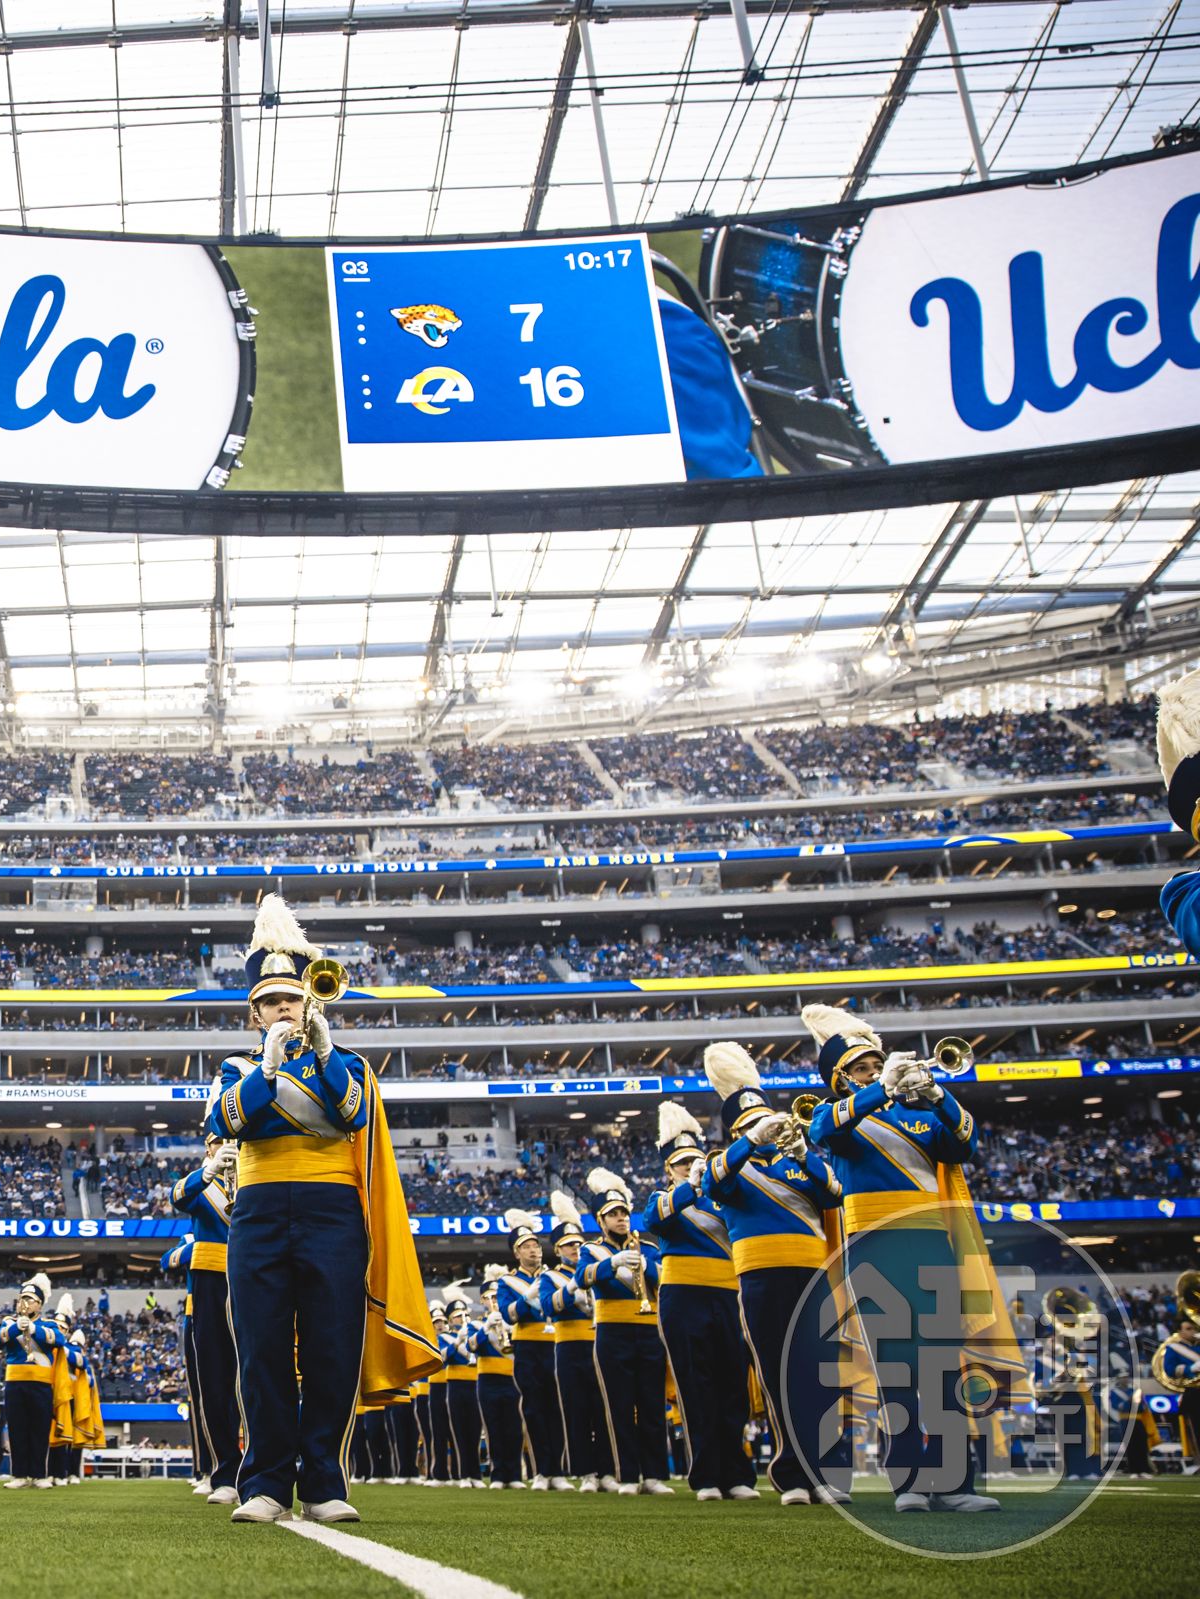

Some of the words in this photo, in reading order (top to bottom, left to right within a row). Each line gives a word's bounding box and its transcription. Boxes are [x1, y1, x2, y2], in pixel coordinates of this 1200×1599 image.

[564, 249, 632, 270] 10:17
[341, 261, 368, 276] Q3
[509, 303, 544, 343] 7
[519, 365, 585, 408] 16
[544, 855, 600, 867] RAMS
[609, 853, 675, 865] HOUSE
[106, 866, 144, 876] OUR
[154, 866, 218, 876] HOUSE
[314, 863, 364, 874] YOUR
[374, 862, 438, 872] HOUSE
[774, 1077, 797, 1085] Down
[6, 1089, 87, 1098] #RAMSHOUSE
[184, 1089, 210, 1099] 10:1
[982, 1203, 1062, 1222] USE
[0, 1220, 125, 1236] HOUSE
